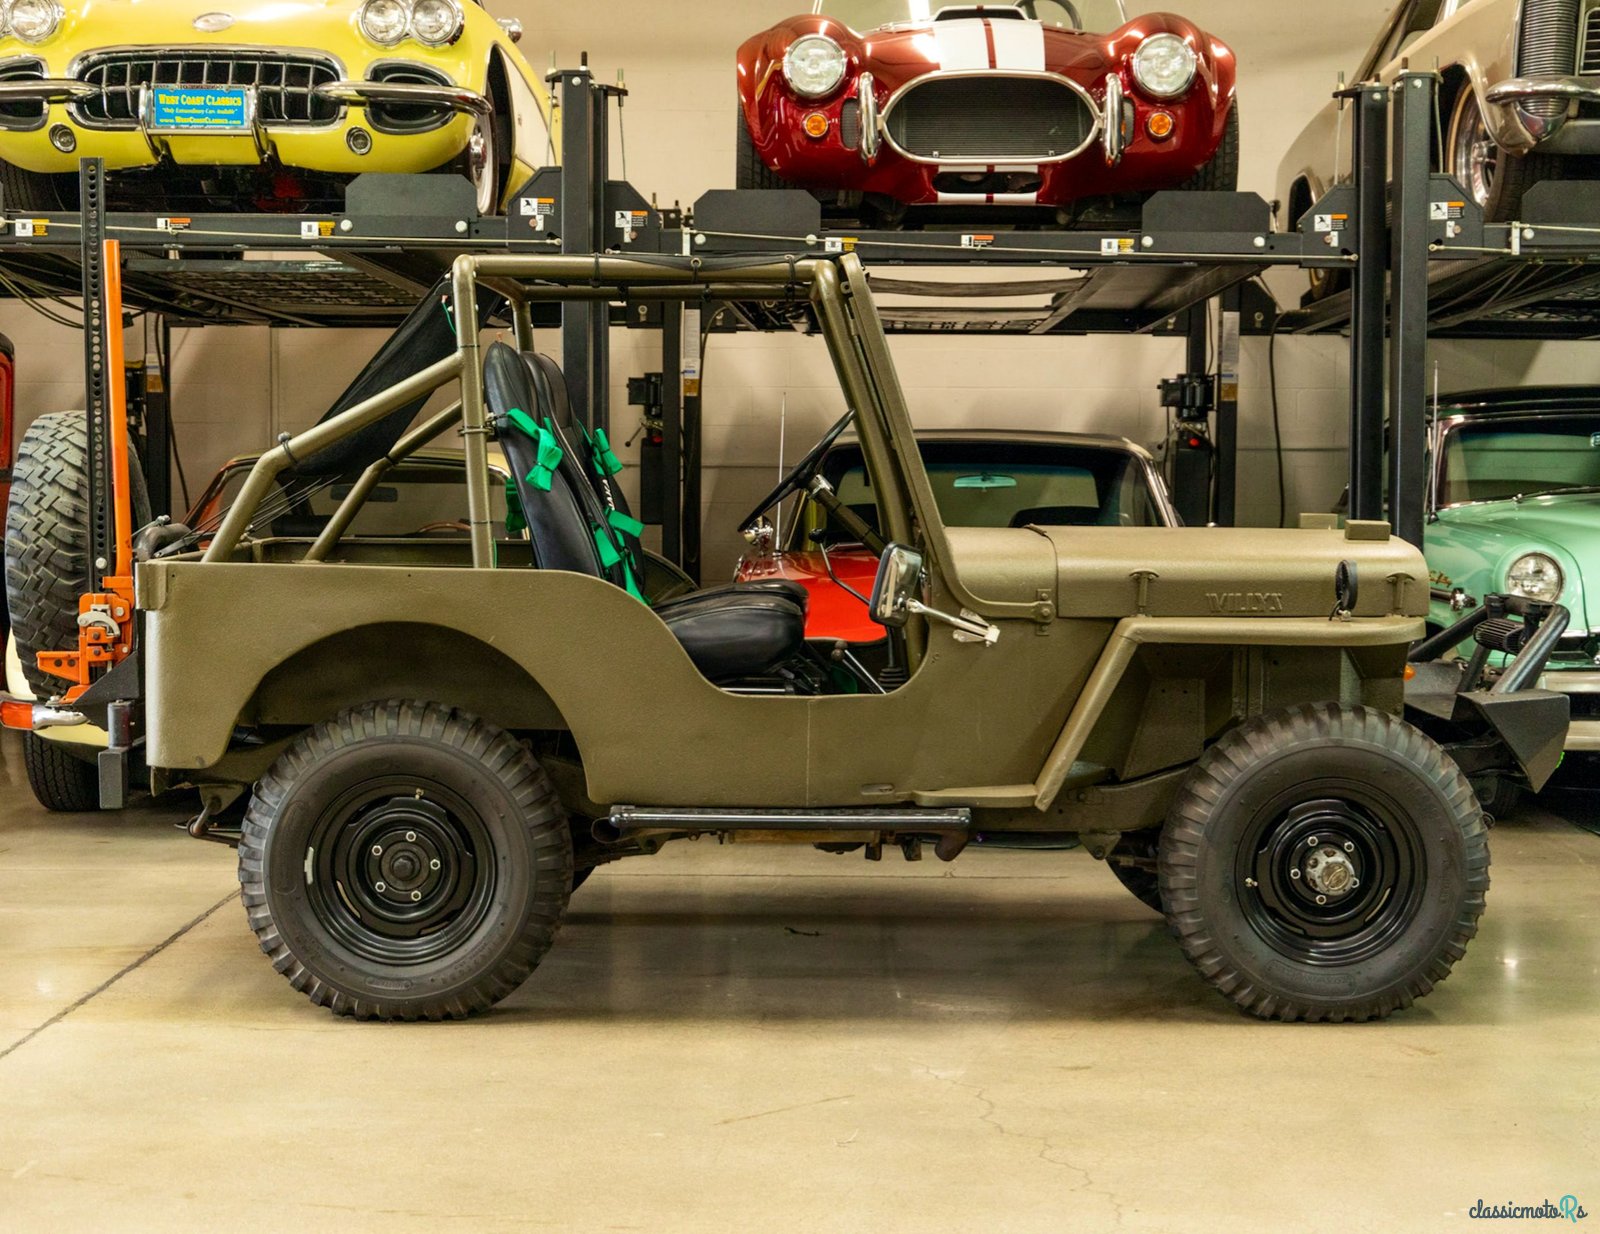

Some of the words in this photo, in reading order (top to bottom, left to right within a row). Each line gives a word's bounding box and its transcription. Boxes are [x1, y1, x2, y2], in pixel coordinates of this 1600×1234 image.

[158, 94, 179, 105] WEST
[181, 95, 205, 106] COAST
[206, 95, 242, 106] CLASSICS
[1205, 591, 1282, 612] WILLYS
